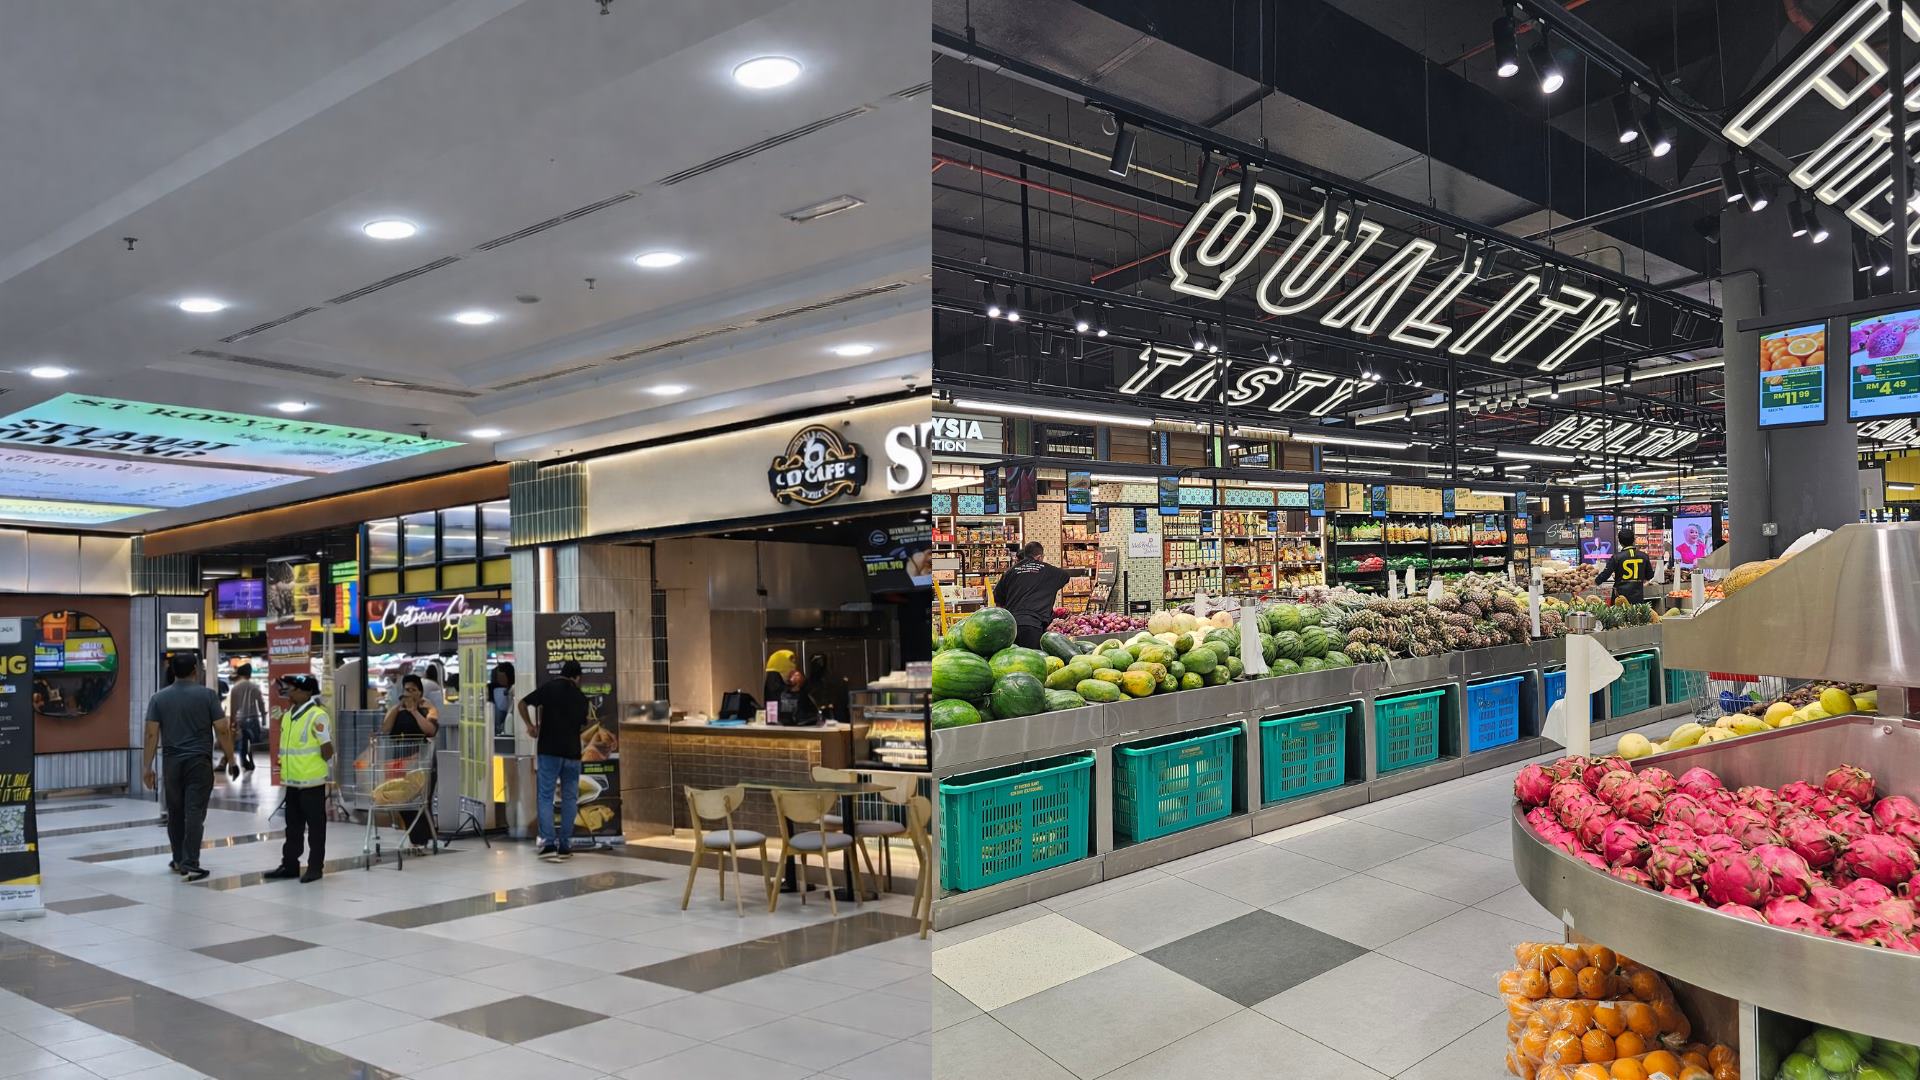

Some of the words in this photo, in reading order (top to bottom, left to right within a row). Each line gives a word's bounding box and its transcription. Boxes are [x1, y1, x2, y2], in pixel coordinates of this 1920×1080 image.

[1169, 182, 1636, 371] QUALITY
[1119, 346, 1376, 416] TASTY
[1530, 414, 1699, 458] HEALTHY
[1622, 558, 1643, 580] ST
